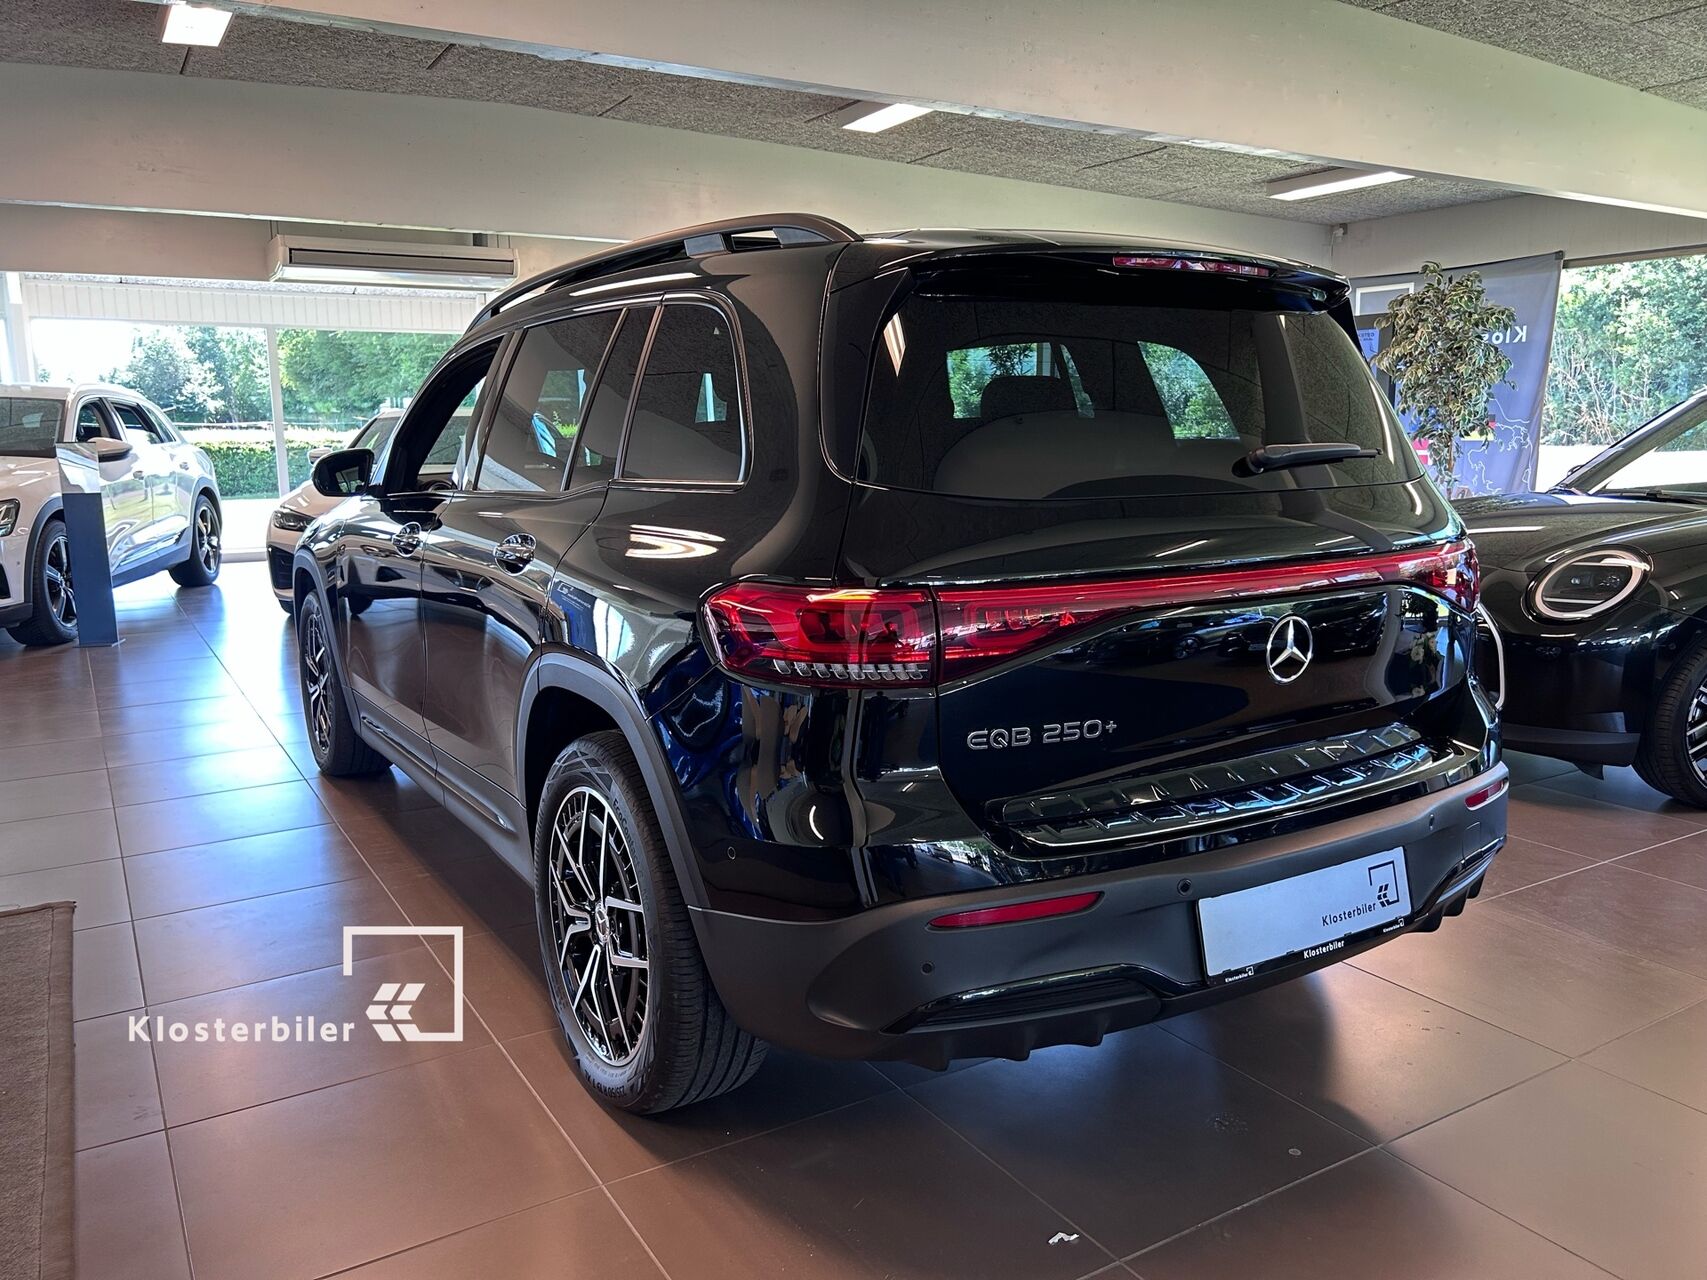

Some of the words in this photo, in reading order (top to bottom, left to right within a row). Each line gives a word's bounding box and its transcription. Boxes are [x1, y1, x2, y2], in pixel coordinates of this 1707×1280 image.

[966, 727, 1032, 750] EQB
[1042, 719, 1117, 744] 250+
[1321, 902, 1377, 927] Klosterbiler
[1303, 940, 1345, 959] Klosterbiler
